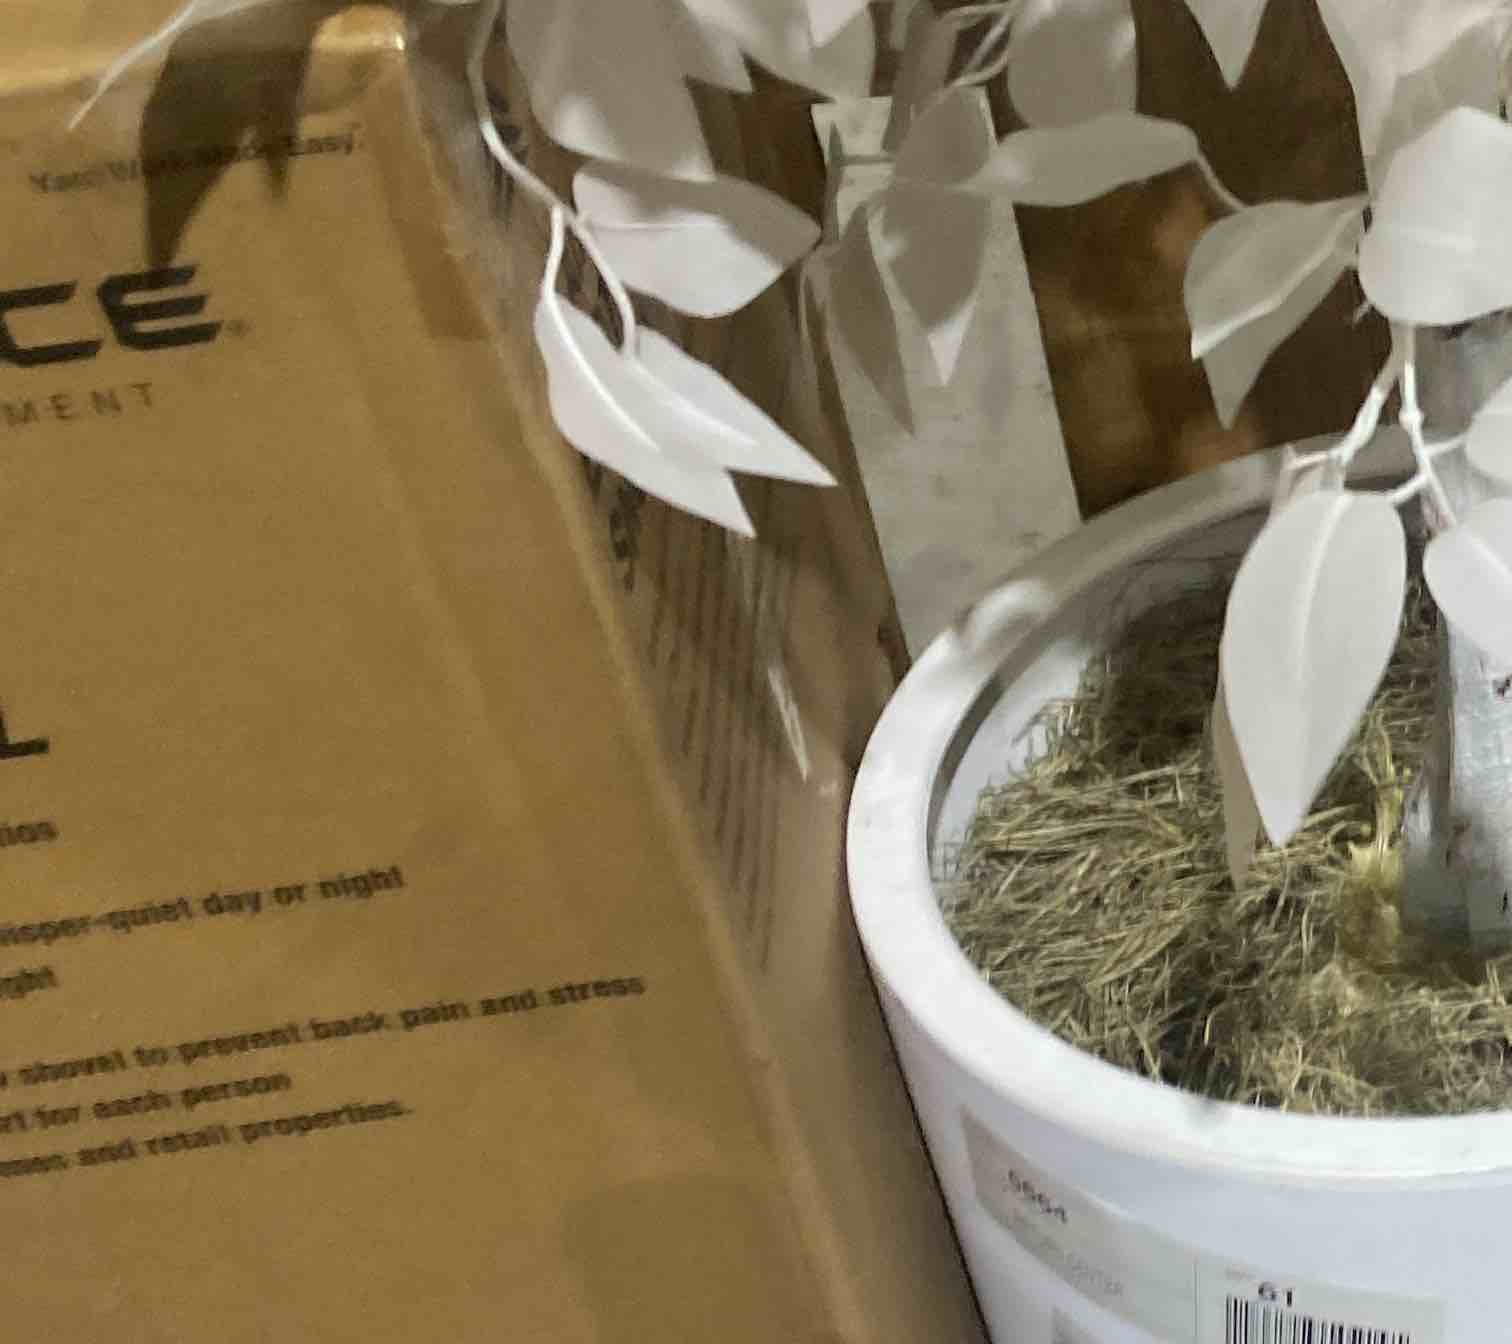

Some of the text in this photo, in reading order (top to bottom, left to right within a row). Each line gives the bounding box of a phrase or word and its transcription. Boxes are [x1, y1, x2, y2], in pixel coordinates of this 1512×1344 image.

[203, 889, 263, 918] day
[273, 882, 306, 906] or
[319, 865, 403, 900] night
[18, 1049, 127, 1087] shovel
[132, 1044, 170, 1069] to
[176, 1023, 300, 1067] prevent
[307, 1009, 389, 1043] back
[398, 998, 472, 1033] pain
[478, 987, 538, 1017] and
[545, 975, 647, 1007] stress
[33, 1104, 80, 1130] for
[92, 1089, 172, 1121] each
[181, 1071, 292, 1112] person
[77, 1136, 139, 1168] and
[144, 1123, 232, 1158] retail
